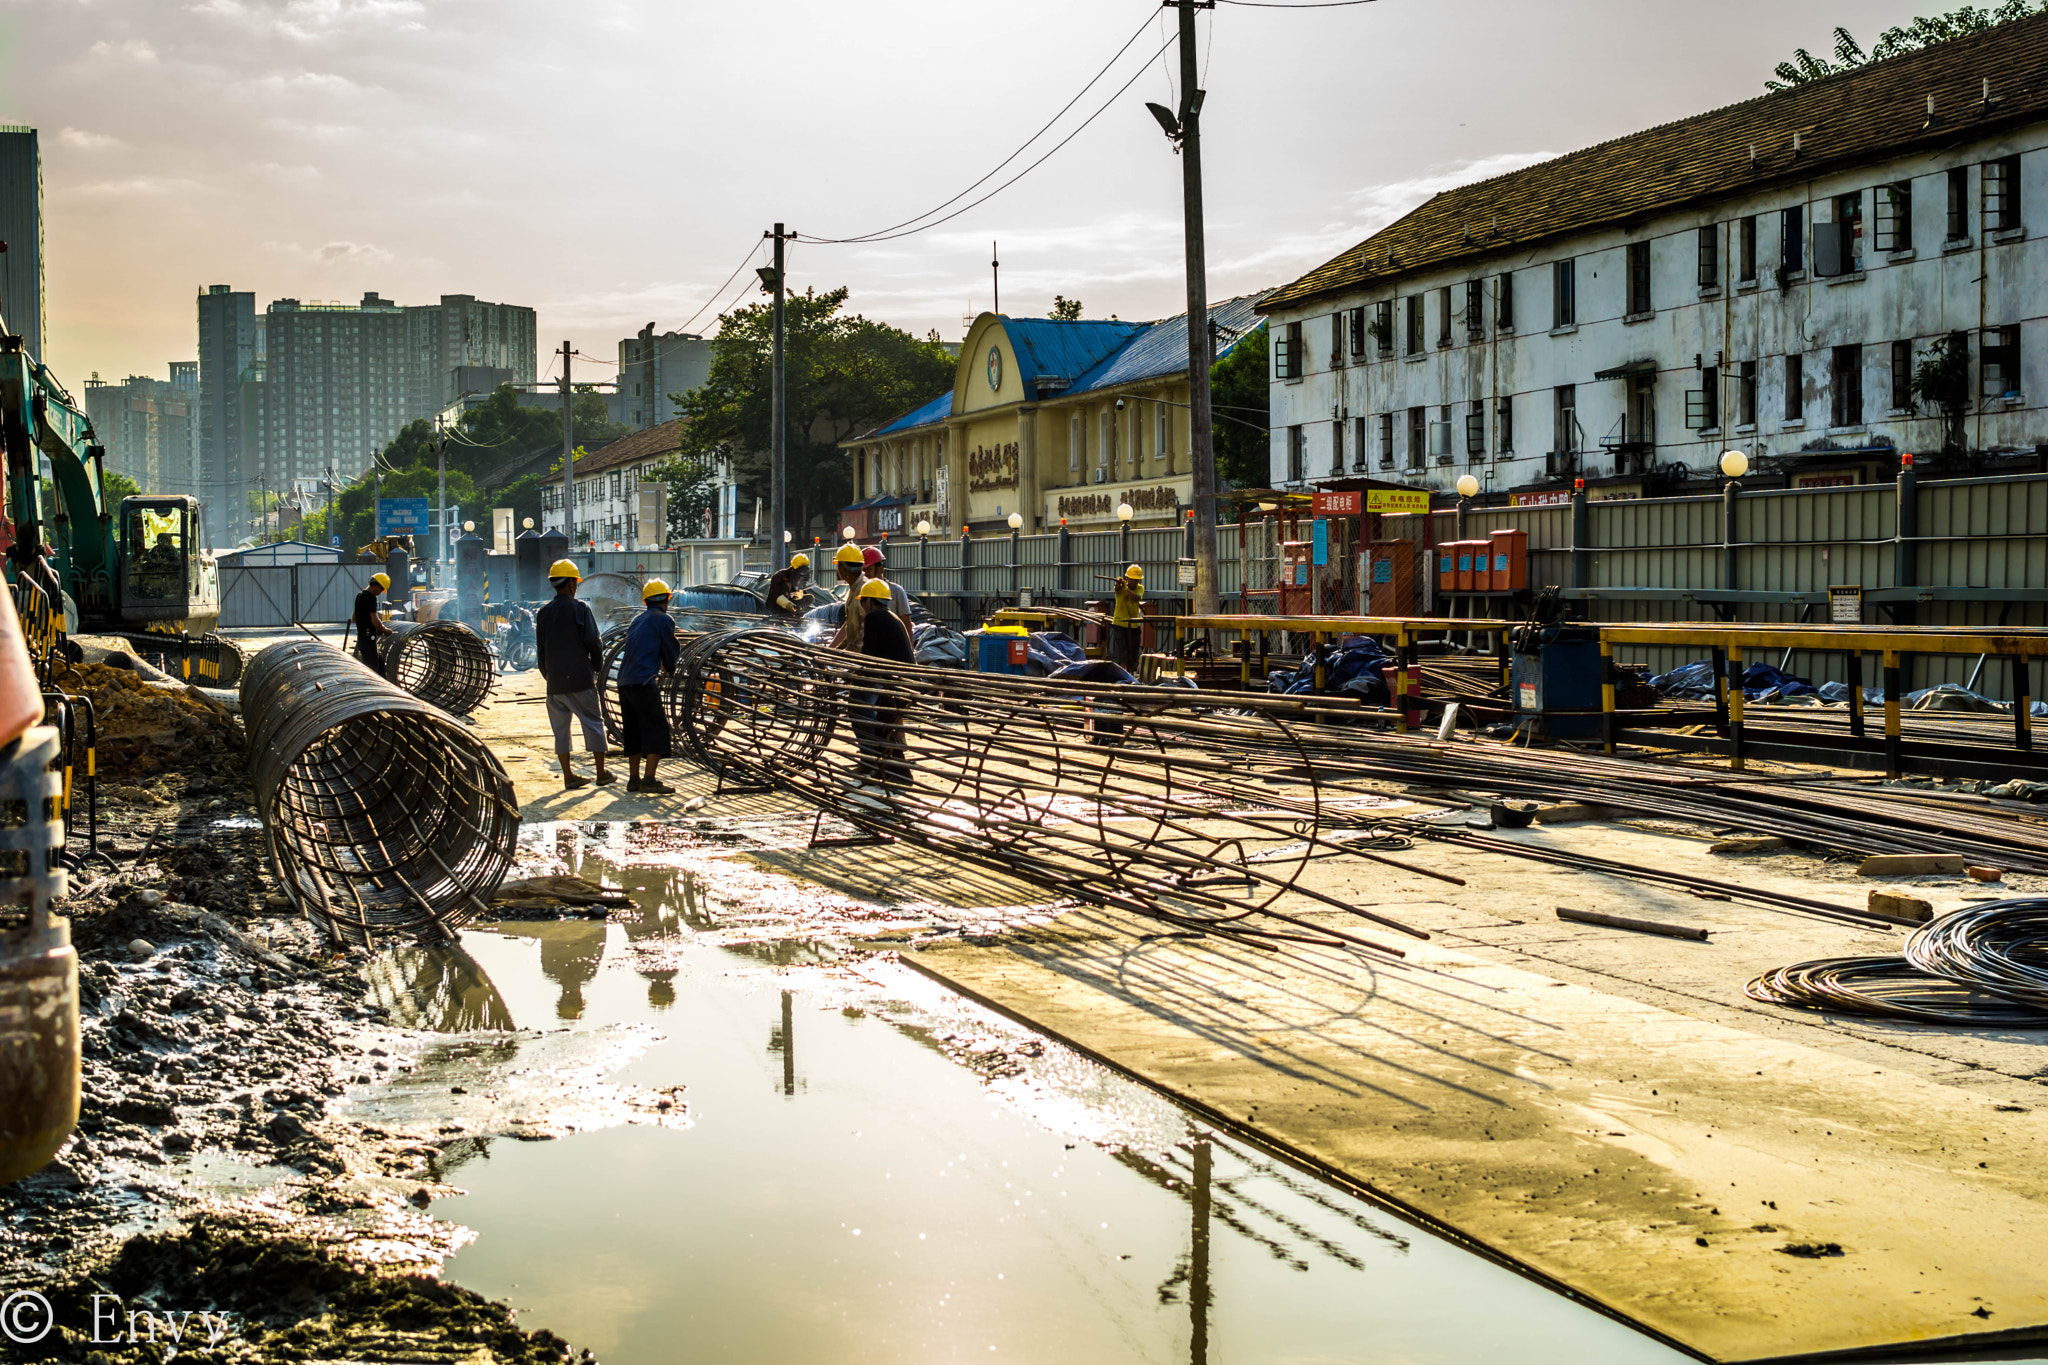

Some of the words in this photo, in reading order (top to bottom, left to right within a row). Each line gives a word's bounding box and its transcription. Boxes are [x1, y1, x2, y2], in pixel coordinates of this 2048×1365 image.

[1319, 496, 1352, 511] 二级配电柜
[1389, 494, 1421, 503] 有电危险
